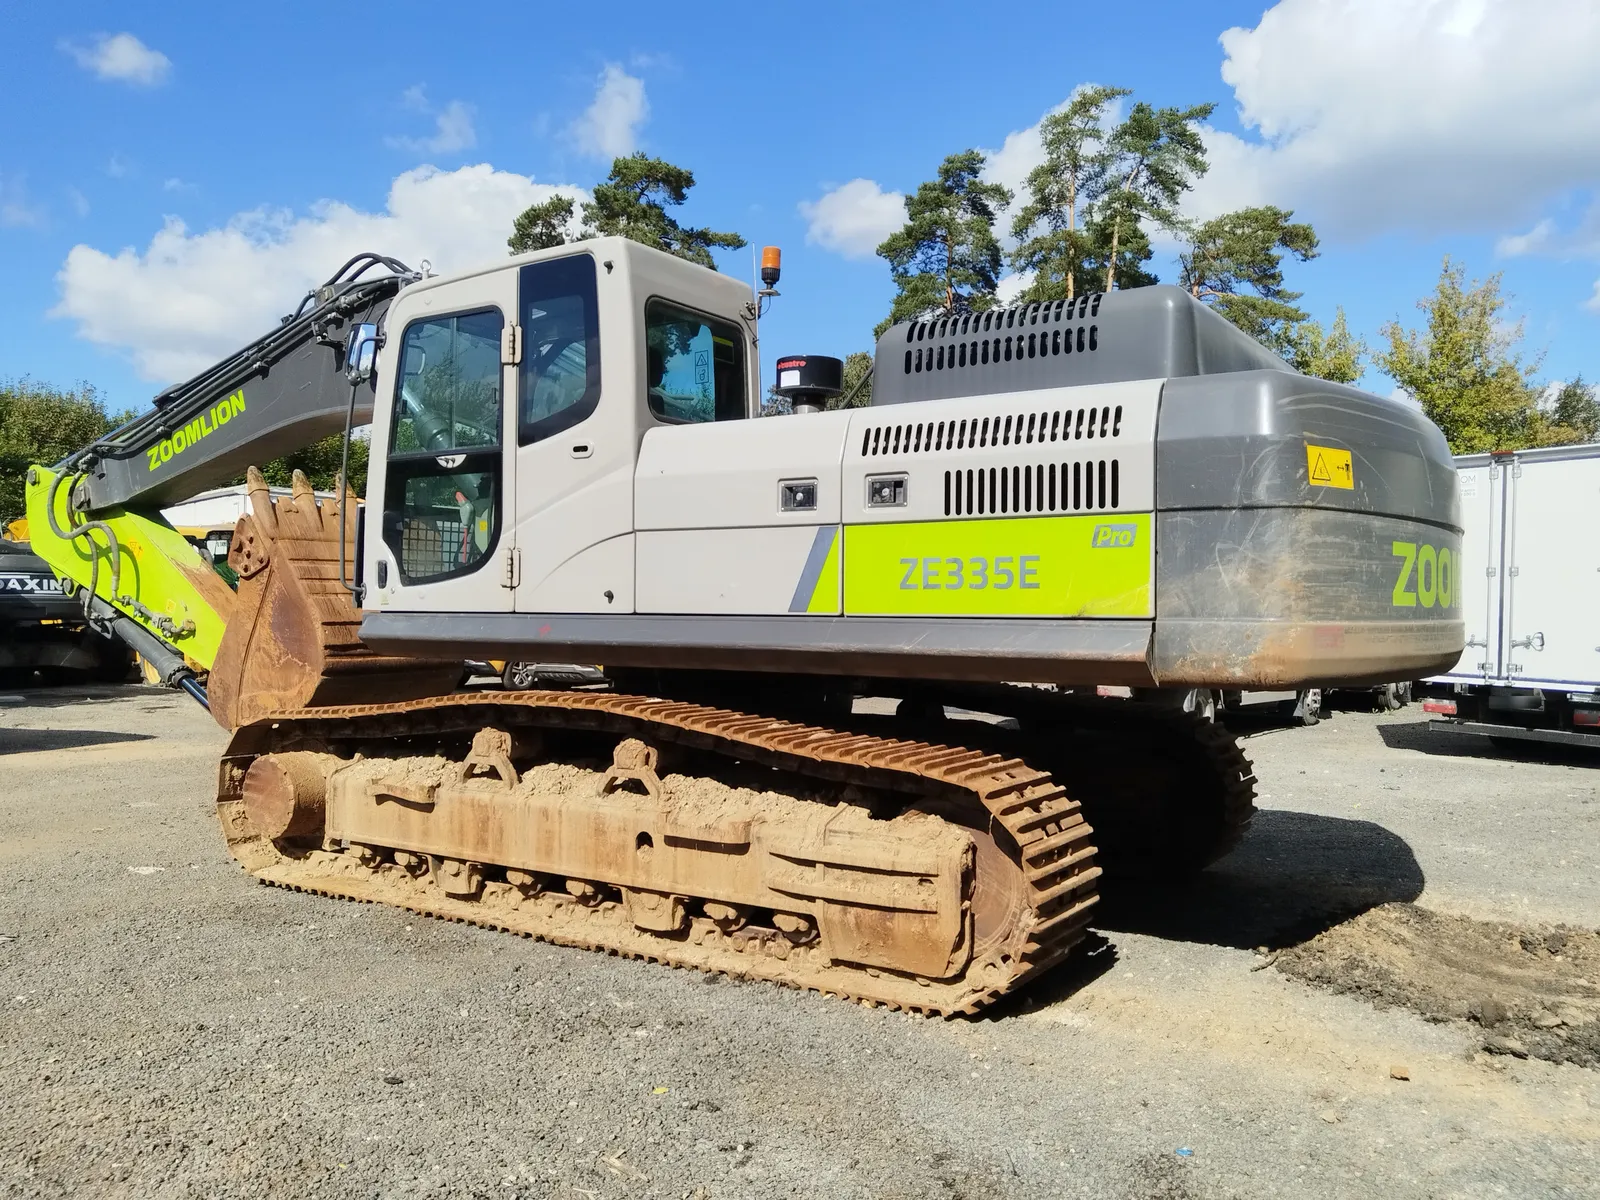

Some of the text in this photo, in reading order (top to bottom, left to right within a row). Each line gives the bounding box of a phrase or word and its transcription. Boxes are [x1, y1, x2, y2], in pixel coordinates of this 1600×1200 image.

[146, 389, 247, 472] ZOOMLION
[1096, 526, 1132, 546] Pro
[899, 555, 1041, 590] ZE335E
